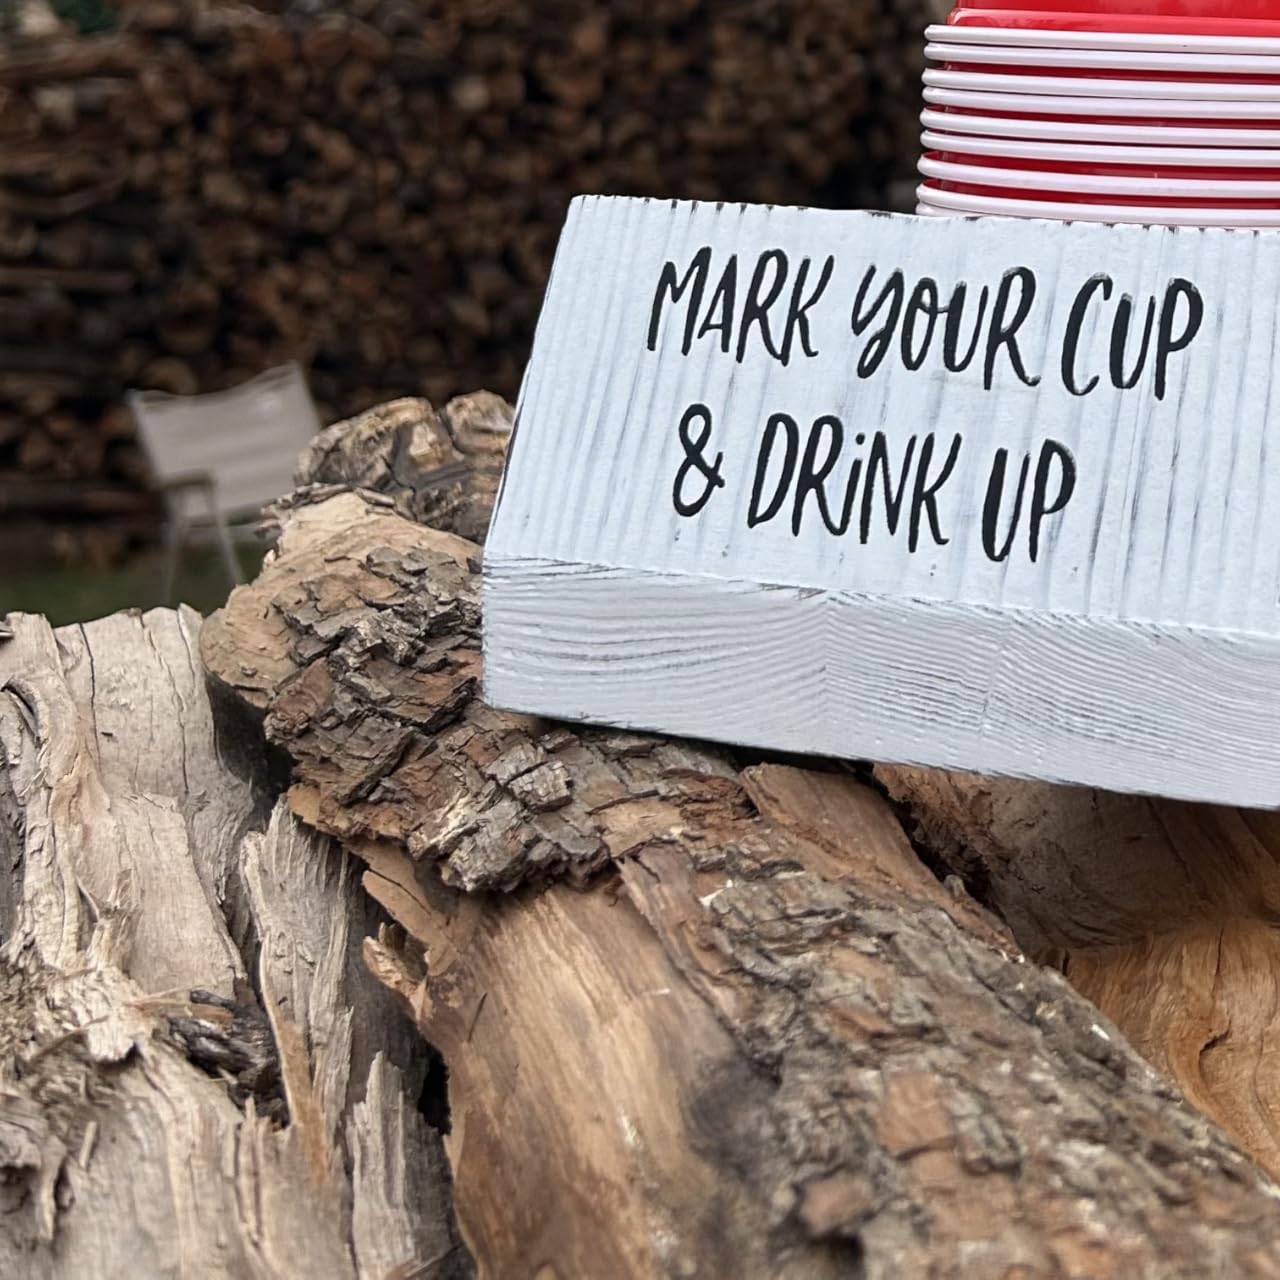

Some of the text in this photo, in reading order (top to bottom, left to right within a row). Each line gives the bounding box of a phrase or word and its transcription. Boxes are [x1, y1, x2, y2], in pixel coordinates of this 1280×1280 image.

[647, 246, 834, 367] MARK
[1061, 275, 1204, 401] CUP
[672, 403, 725, 518] &
[981, 439, 1077, 563] UP
